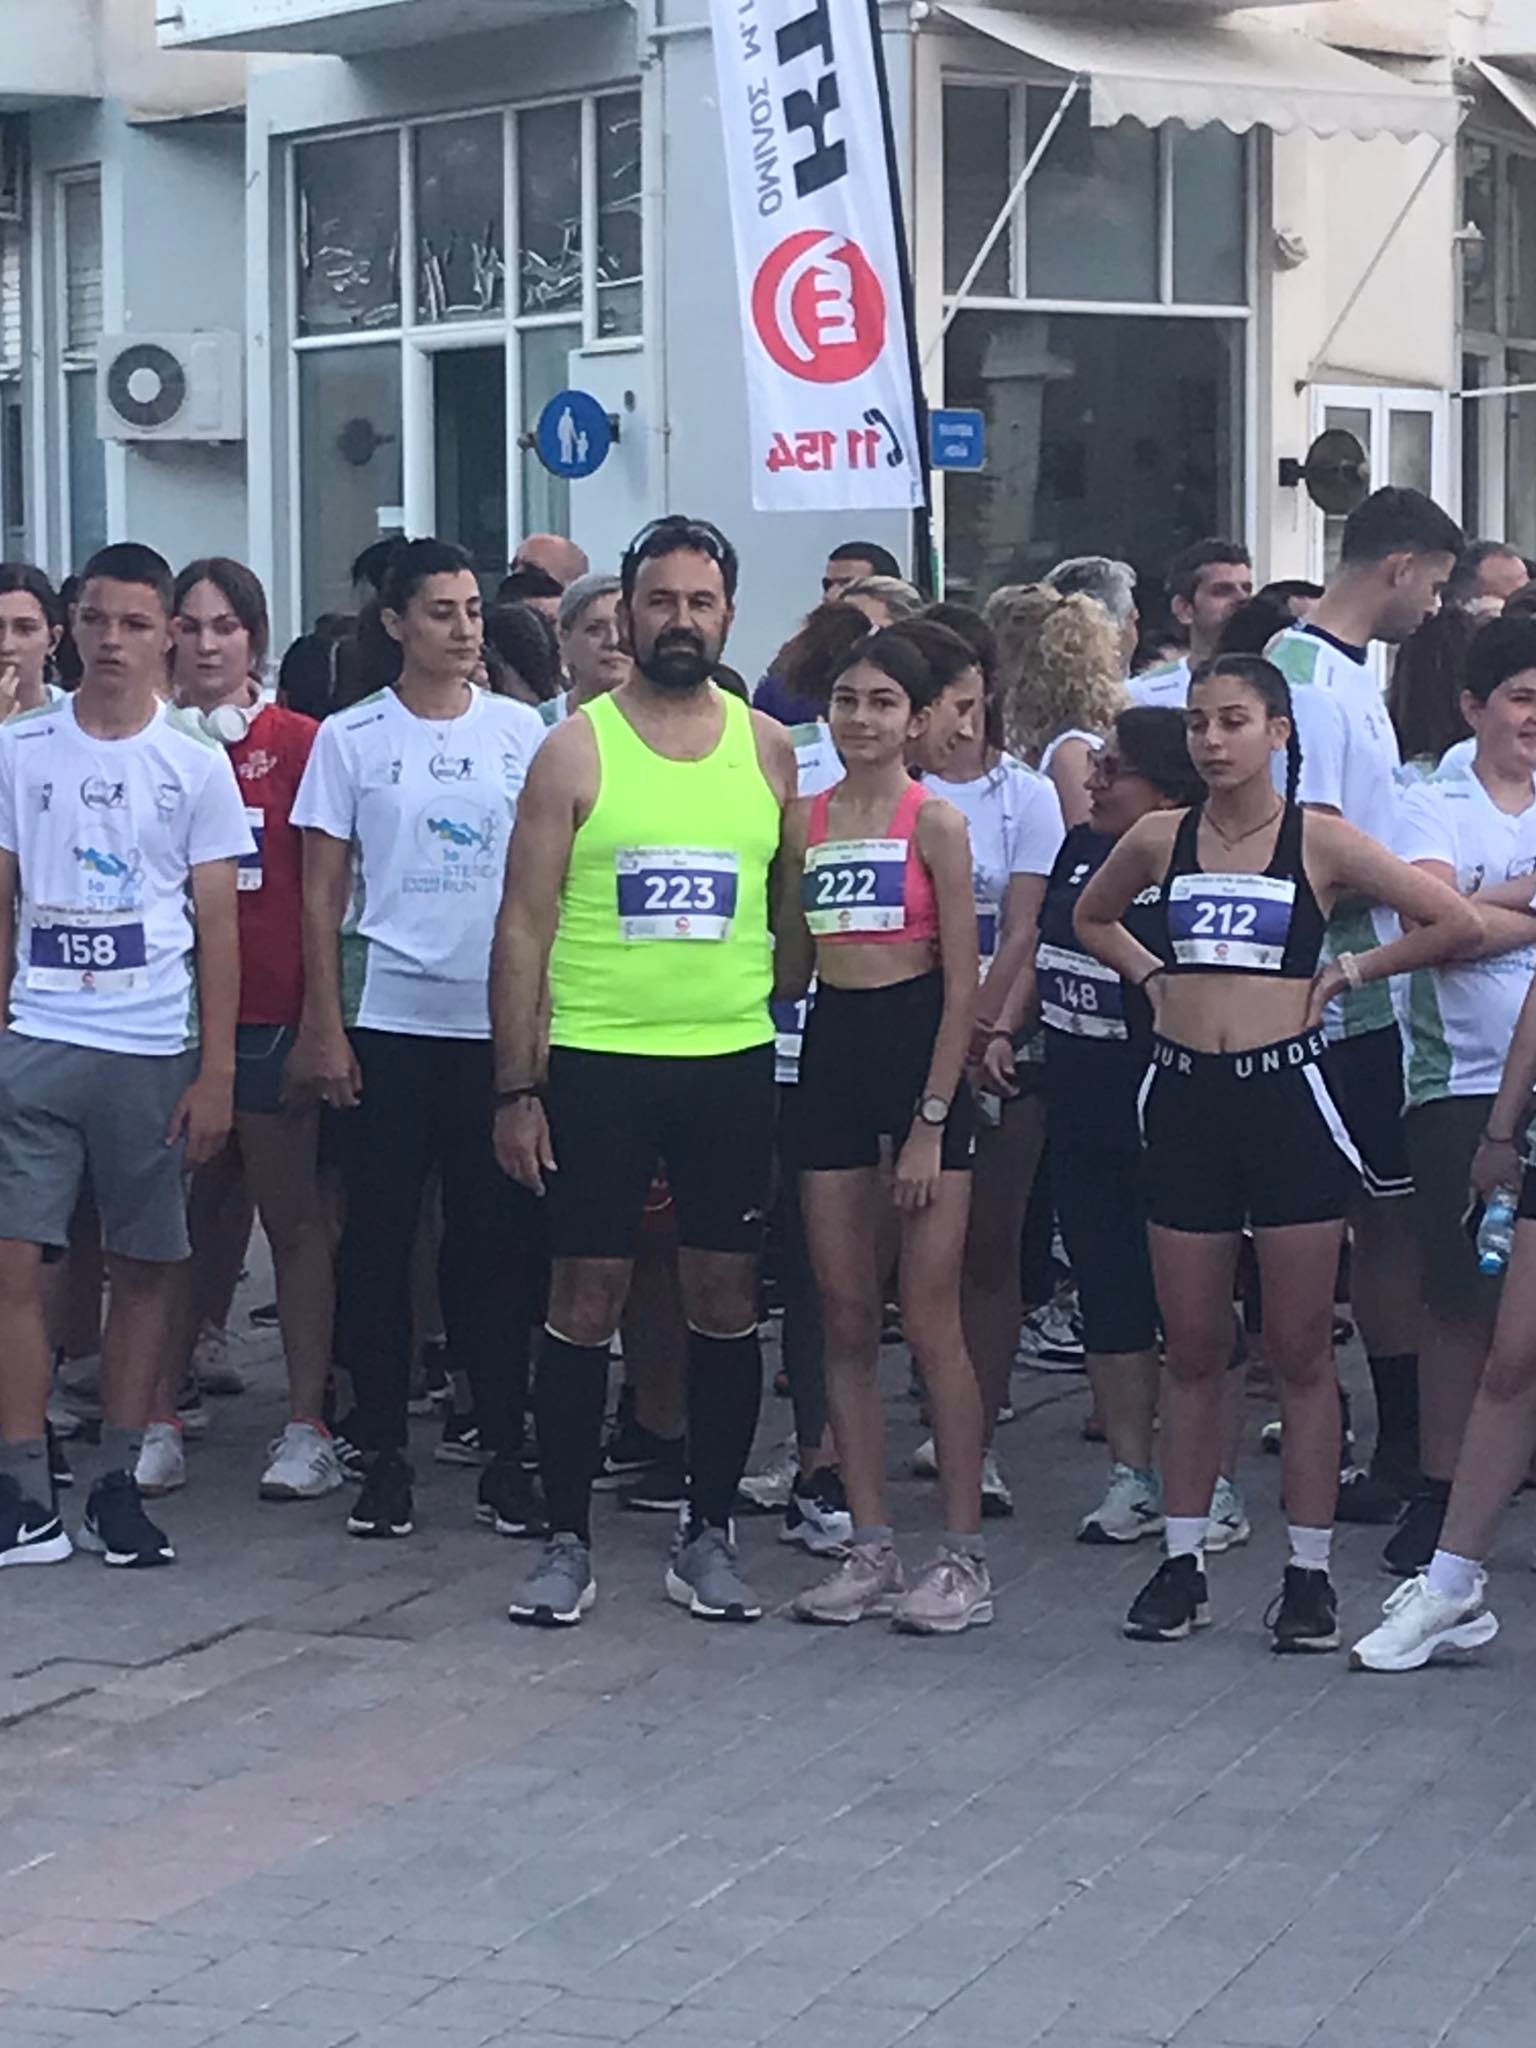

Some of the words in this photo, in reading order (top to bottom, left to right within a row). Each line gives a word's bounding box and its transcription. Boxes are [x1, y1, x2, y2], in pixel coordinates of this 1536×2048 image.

[643, 875, 716, 910] 223
[816, 868, 876, 905] 222
[1191, 901, 1258, 936] 212
[57, 932, 117, 966] 158
[1053, 975, 1099, 1011] 148
